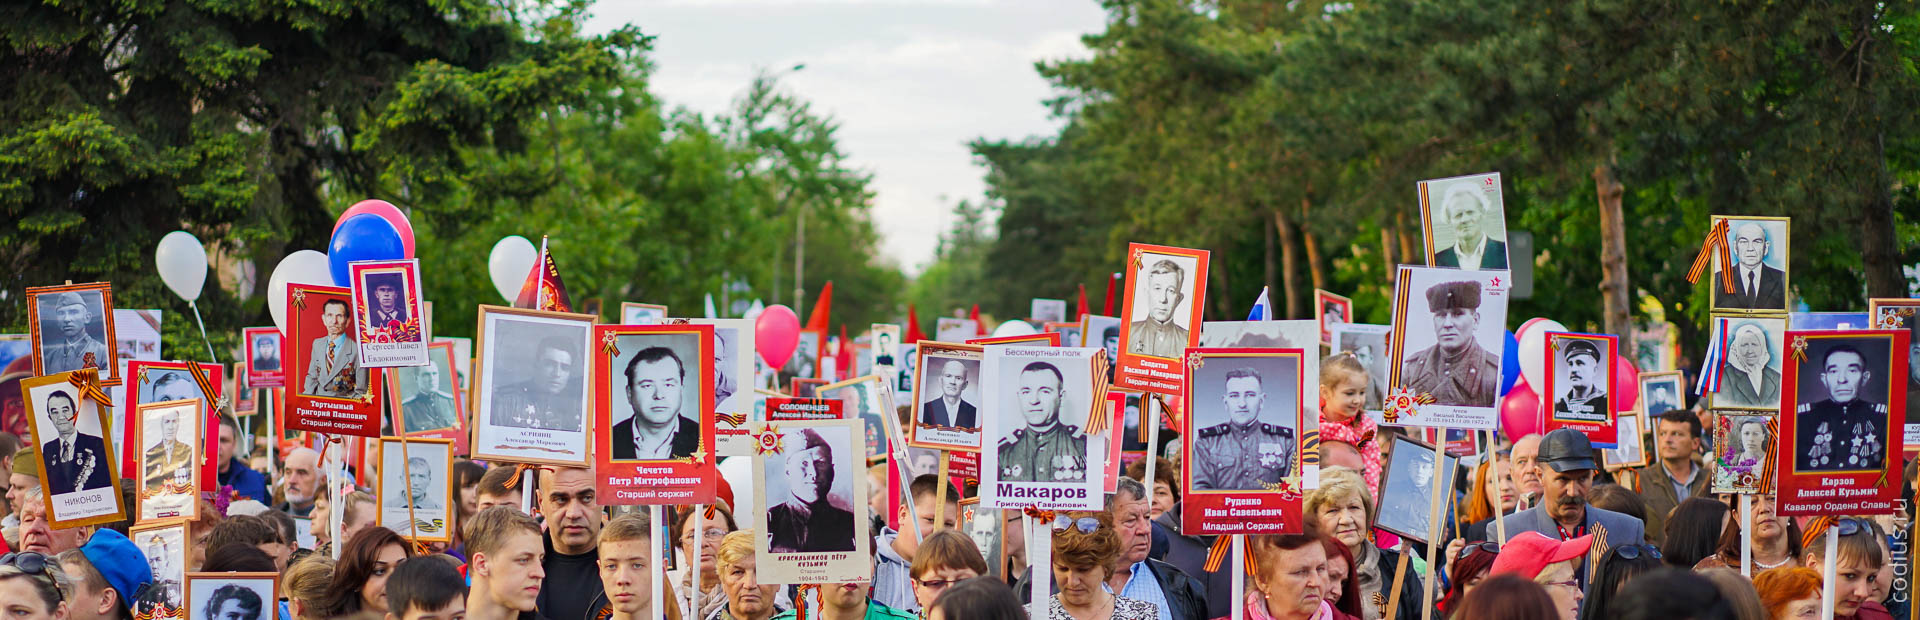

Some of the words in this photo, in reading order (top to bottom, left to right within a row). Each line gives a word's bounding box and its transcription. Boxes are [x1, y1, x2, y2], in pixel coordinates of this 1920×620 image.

[1005, 348, 1059, 357] Бессмертный
[367, 354, 417, 362] Евдокимович
[1123, 365, 1149, 376] Василий
[779, 403, 830, 411] СОЛОМЕНЦЕВ
[296, 407, 331, 418] Григорий
[332, 411, 368, 420] Павлович
[300, 418, 332, 427] Старший
[333, 421, 363, 430] сержант
[636, 466, 673, 474] Чечетов
[609, 477, 632, 486] Петр
[633, 476, 701, 486] Митрофанович
[1821, 477, 1855, 487] Карзов
[616, 489, 656, 499] Старший
[657, 491, 694, 499] сержант
[996, 483, 1087, 501] Макаров
[1797, 489, 1836, 498] Алексей
[1838, 487, 1878, 497] Кузьмич
[64, 494, 103, 507] НИКОНОВ
[995, 500, 1034, 508] Григорий
[1224, 497, 1262, 507] Руденко
[1784, 503, 1822, 512] Кавалер
[1824, 501, 1859, 511] Ордена
[1860, 500, 1891, 509] Славы
[1204, 508, 1228, 517] Иван
[1229, 507, 1282, 517] Савельевич
[1202, 521, 1244, 532] Младший
[1246, 521, 1285, 531] Сержант
